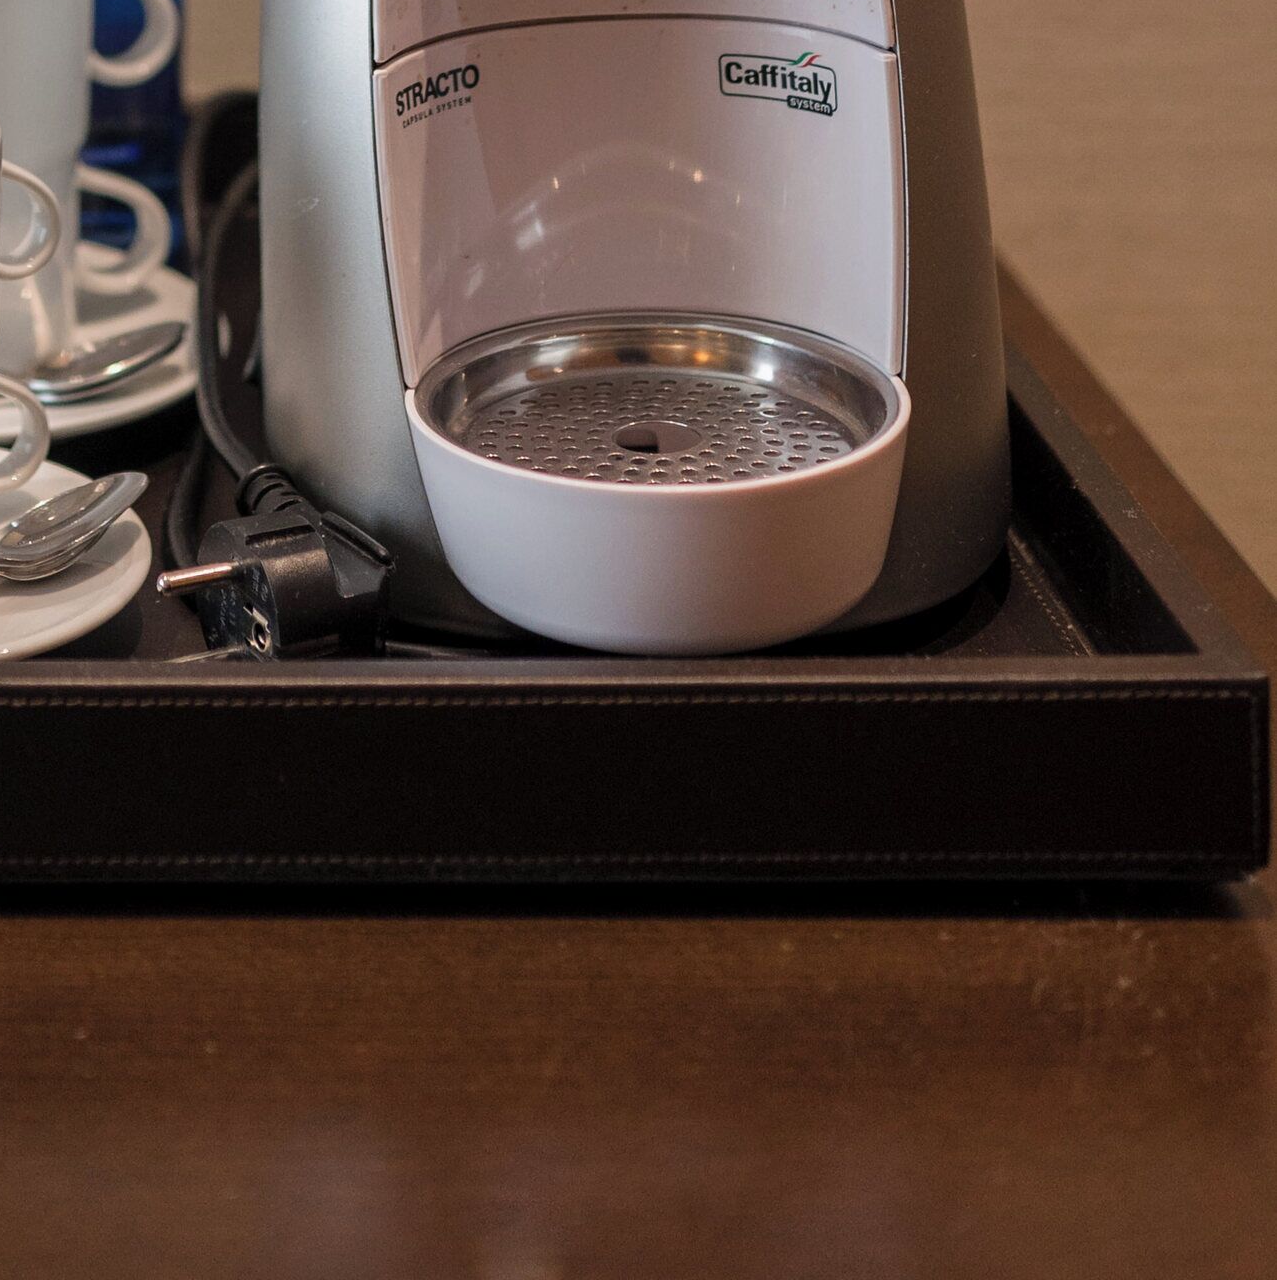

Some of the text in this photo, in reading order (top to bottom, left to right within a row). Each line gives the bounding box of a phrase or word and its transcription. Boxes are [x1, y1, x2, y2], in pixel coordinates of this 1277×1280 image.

[395, 64, 480, 117] STRACTO
[724, 61, 832, 104] Caffitaly
[436, 96, 472, 114] SYSTEM
[789, 98, 831, 114] system
